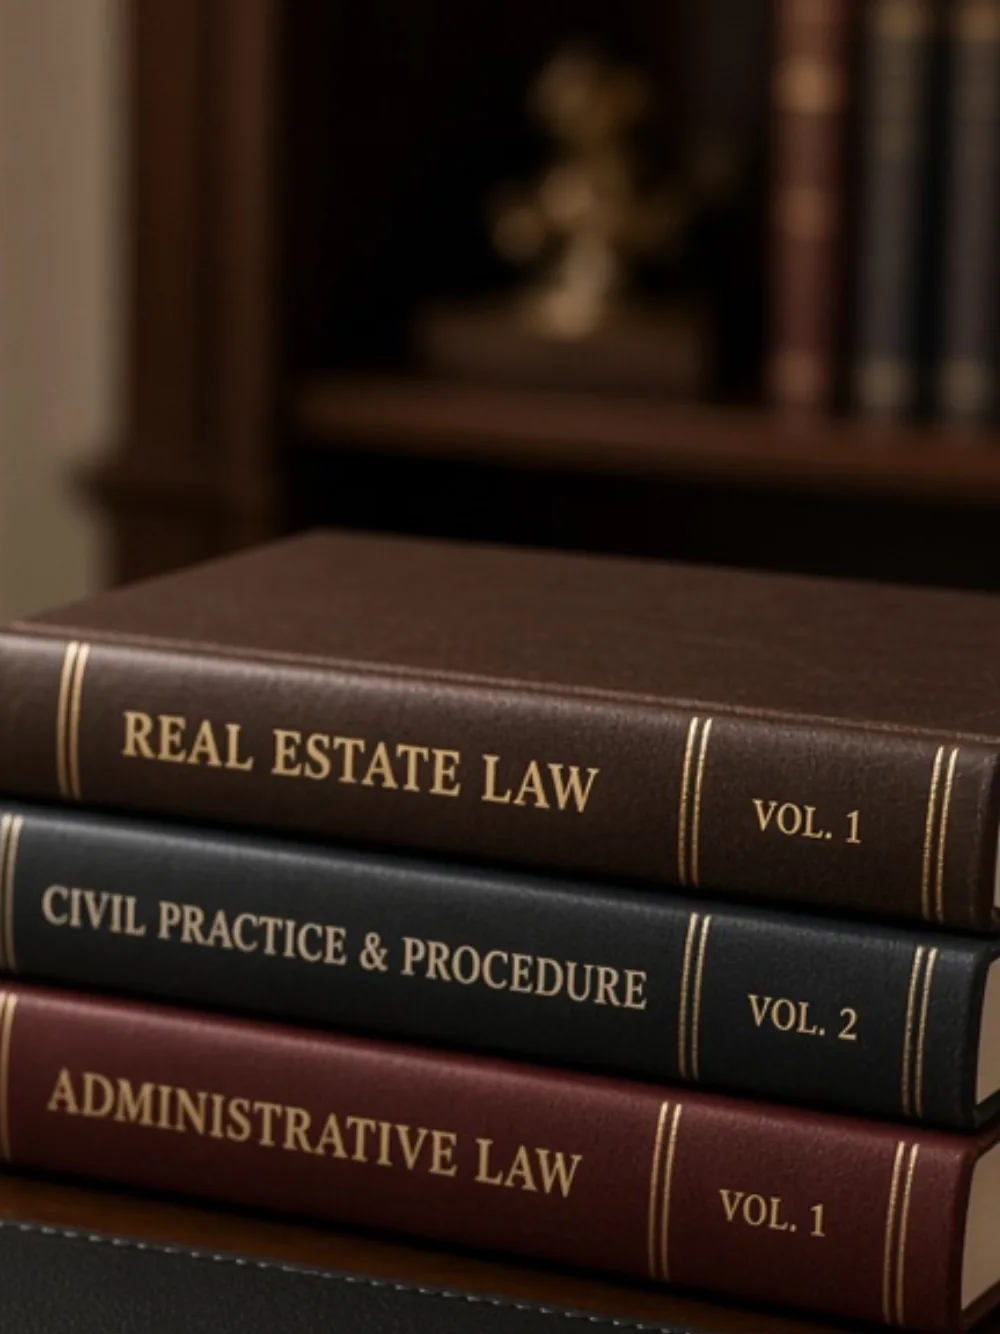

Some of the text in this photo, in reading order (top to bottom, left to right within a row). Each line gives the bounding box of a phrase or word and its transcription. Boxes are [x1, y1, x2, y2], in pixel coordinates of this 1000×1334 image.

[123, 712, 598, 812] REAL ESTATE LAW
[754, 800, 860, 843] VOL. 1
[43, 886, 646, 1009] CIVIL PRACTICE & PROCEDURE
[748, 995, 856, 1040] VOL. 2
[49, 1070, 582, 1197] ADMINISTRATIVE LAW
[720, 1189, 824, 1236] VOL. 1
